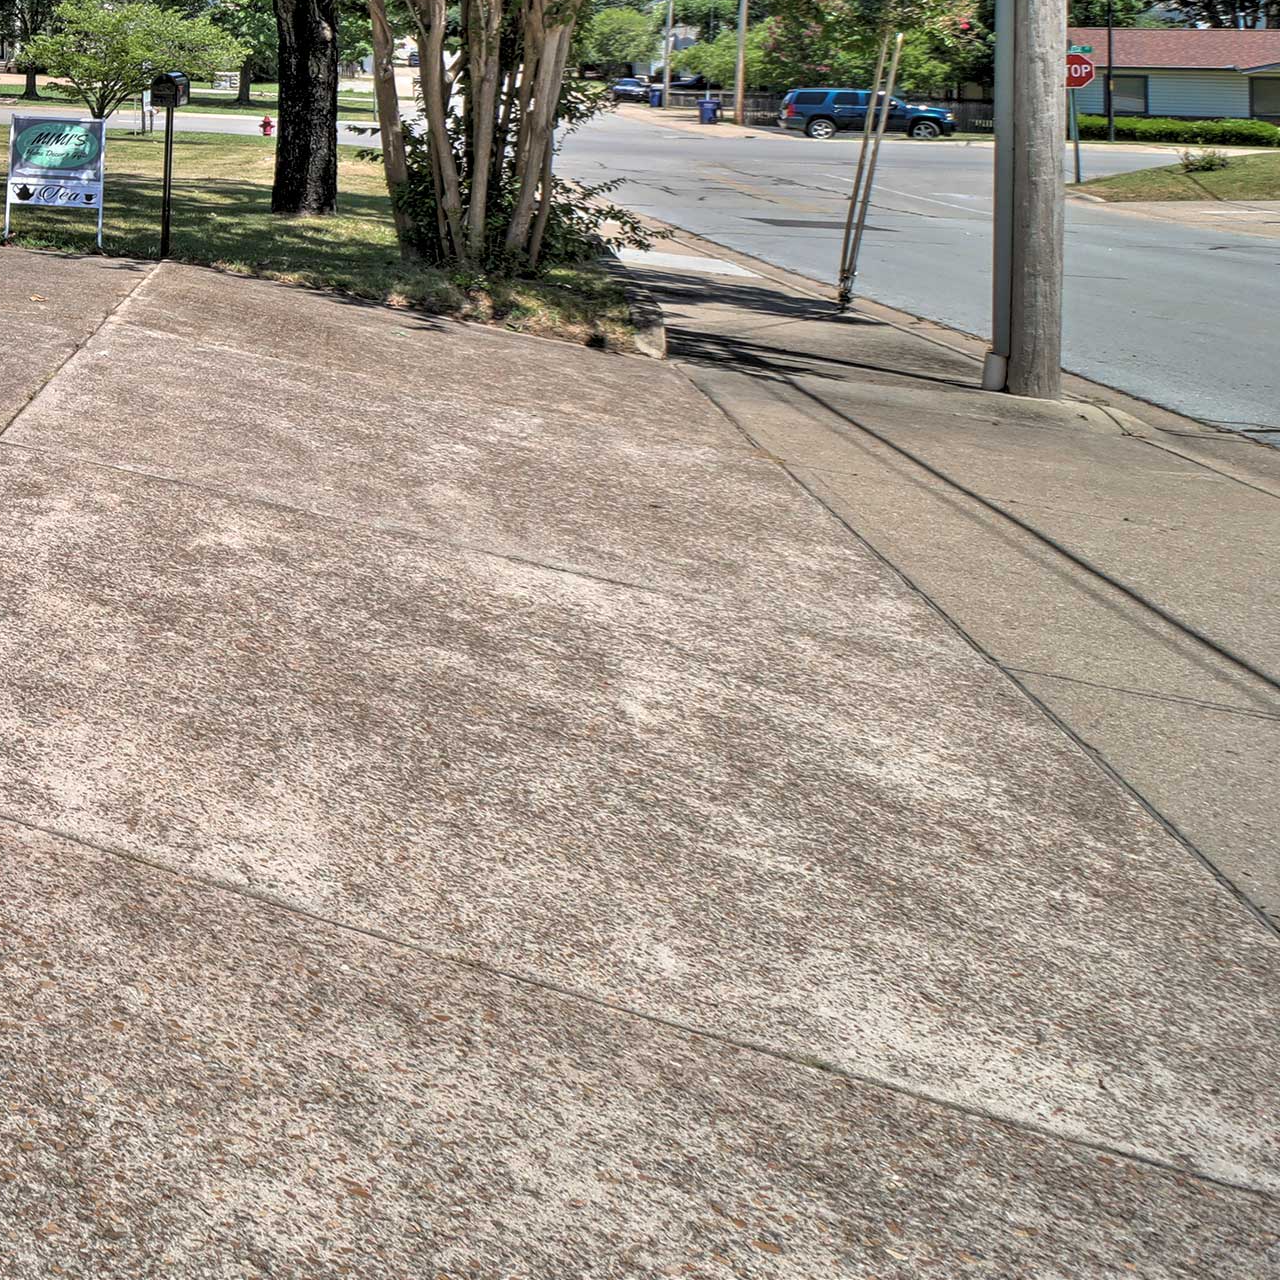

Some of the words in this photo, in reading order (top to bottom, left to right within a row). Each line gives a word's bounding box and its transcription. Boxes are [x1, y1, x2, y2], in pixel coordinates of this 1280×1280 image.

[1066, 64, 1091, 77] TOP
[31, 132, 89, 146] MIMI'S
[37, 184, 81, 203] Tea
